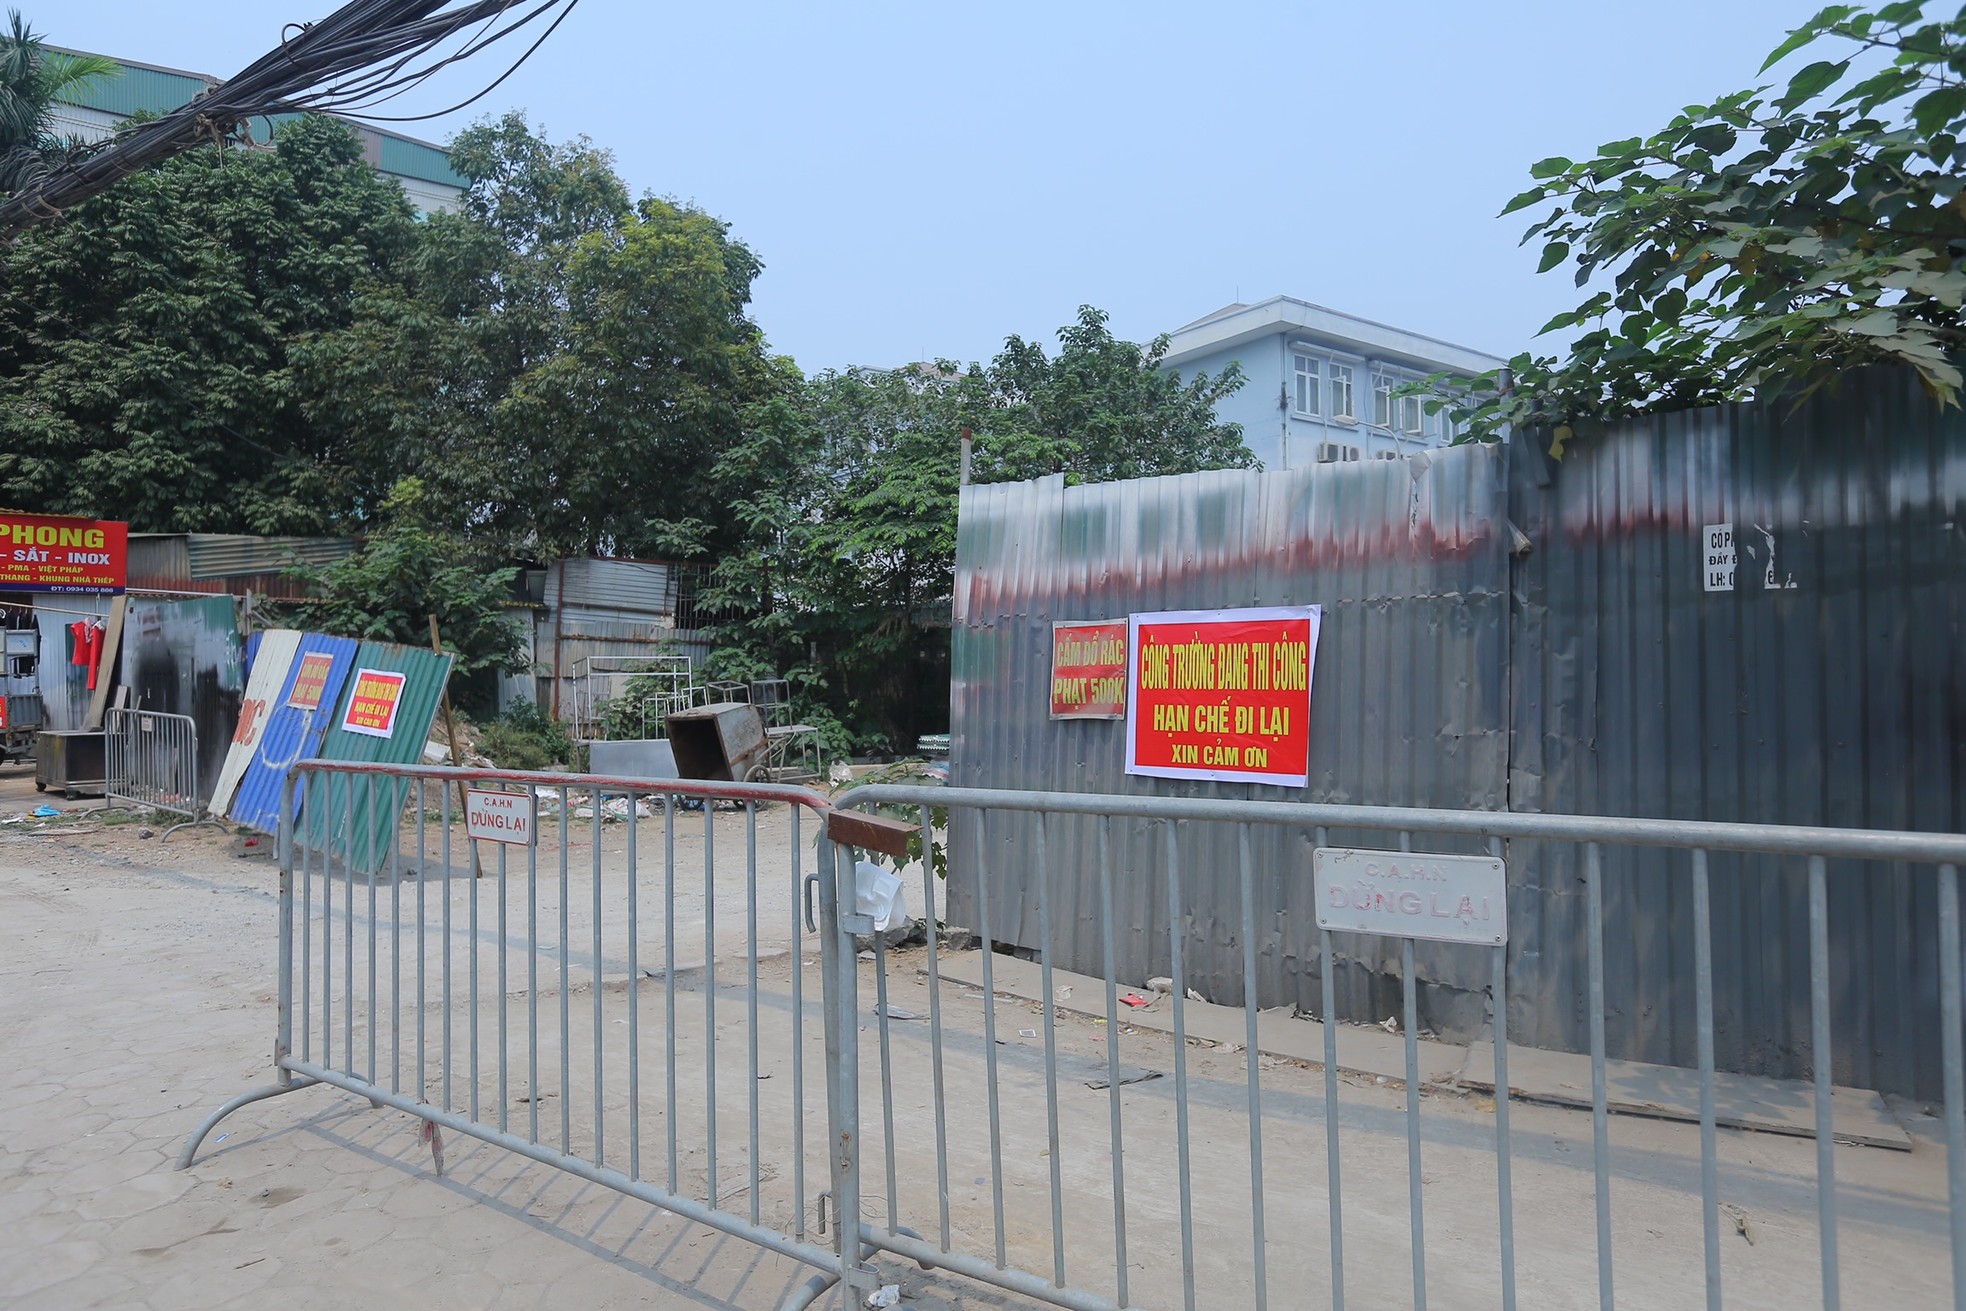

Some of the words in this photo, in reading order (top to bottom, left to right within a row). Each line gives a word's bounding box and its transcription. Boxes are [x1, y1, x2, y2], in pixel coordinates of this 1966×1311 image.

[13, 546, 49, 562] SẮT
[67, 552, 110, 565] INOX
[38, 565, 57, 573] VIỆT
[59, 566, 84, 574] PHÁP
[39, 575, 71, 583] KHUNG
[72, 575, 91, 584] NHÀ
[93, 577, 115, 585] THÉP
[1057, 633, 1081, 667] CẤM
[1101, 634, 1124, 666] RÁC
[1141, 634, 1170, 690] CÔNG
[1172, 631, 1215, 690] TRƯỜNG
[1217, 642, 1249, 690] ĐANG
[1252, 642, 1270, 690] THI
[1272, 631, 1307, 691] CÔNG
[1054, 677, 1087, 710] PHẠT
[1090, 677, 1125, 705] 500K
[1153, 704, 1189, 737] HẠN
[1195, 696, 1232, 734] CHẾ
[1234, 706, 1254, 734] ĐI
[1259, 706, 1290, 742] LẠI
[1171, 744, 1199, 764] XIN
[1203, 738, 1239, 766] CẢM
[1244, 747, 1268, 768] ƠN
[484, 797, 512, 809] C.A.H.N
[505, 815, 526, 835] LẠI
[1365, 862, 1447, 882] C.A.H.N
[1328, 879, 1423, 916] DỪNG
[1430, 891, 1490, 926] LẠI
